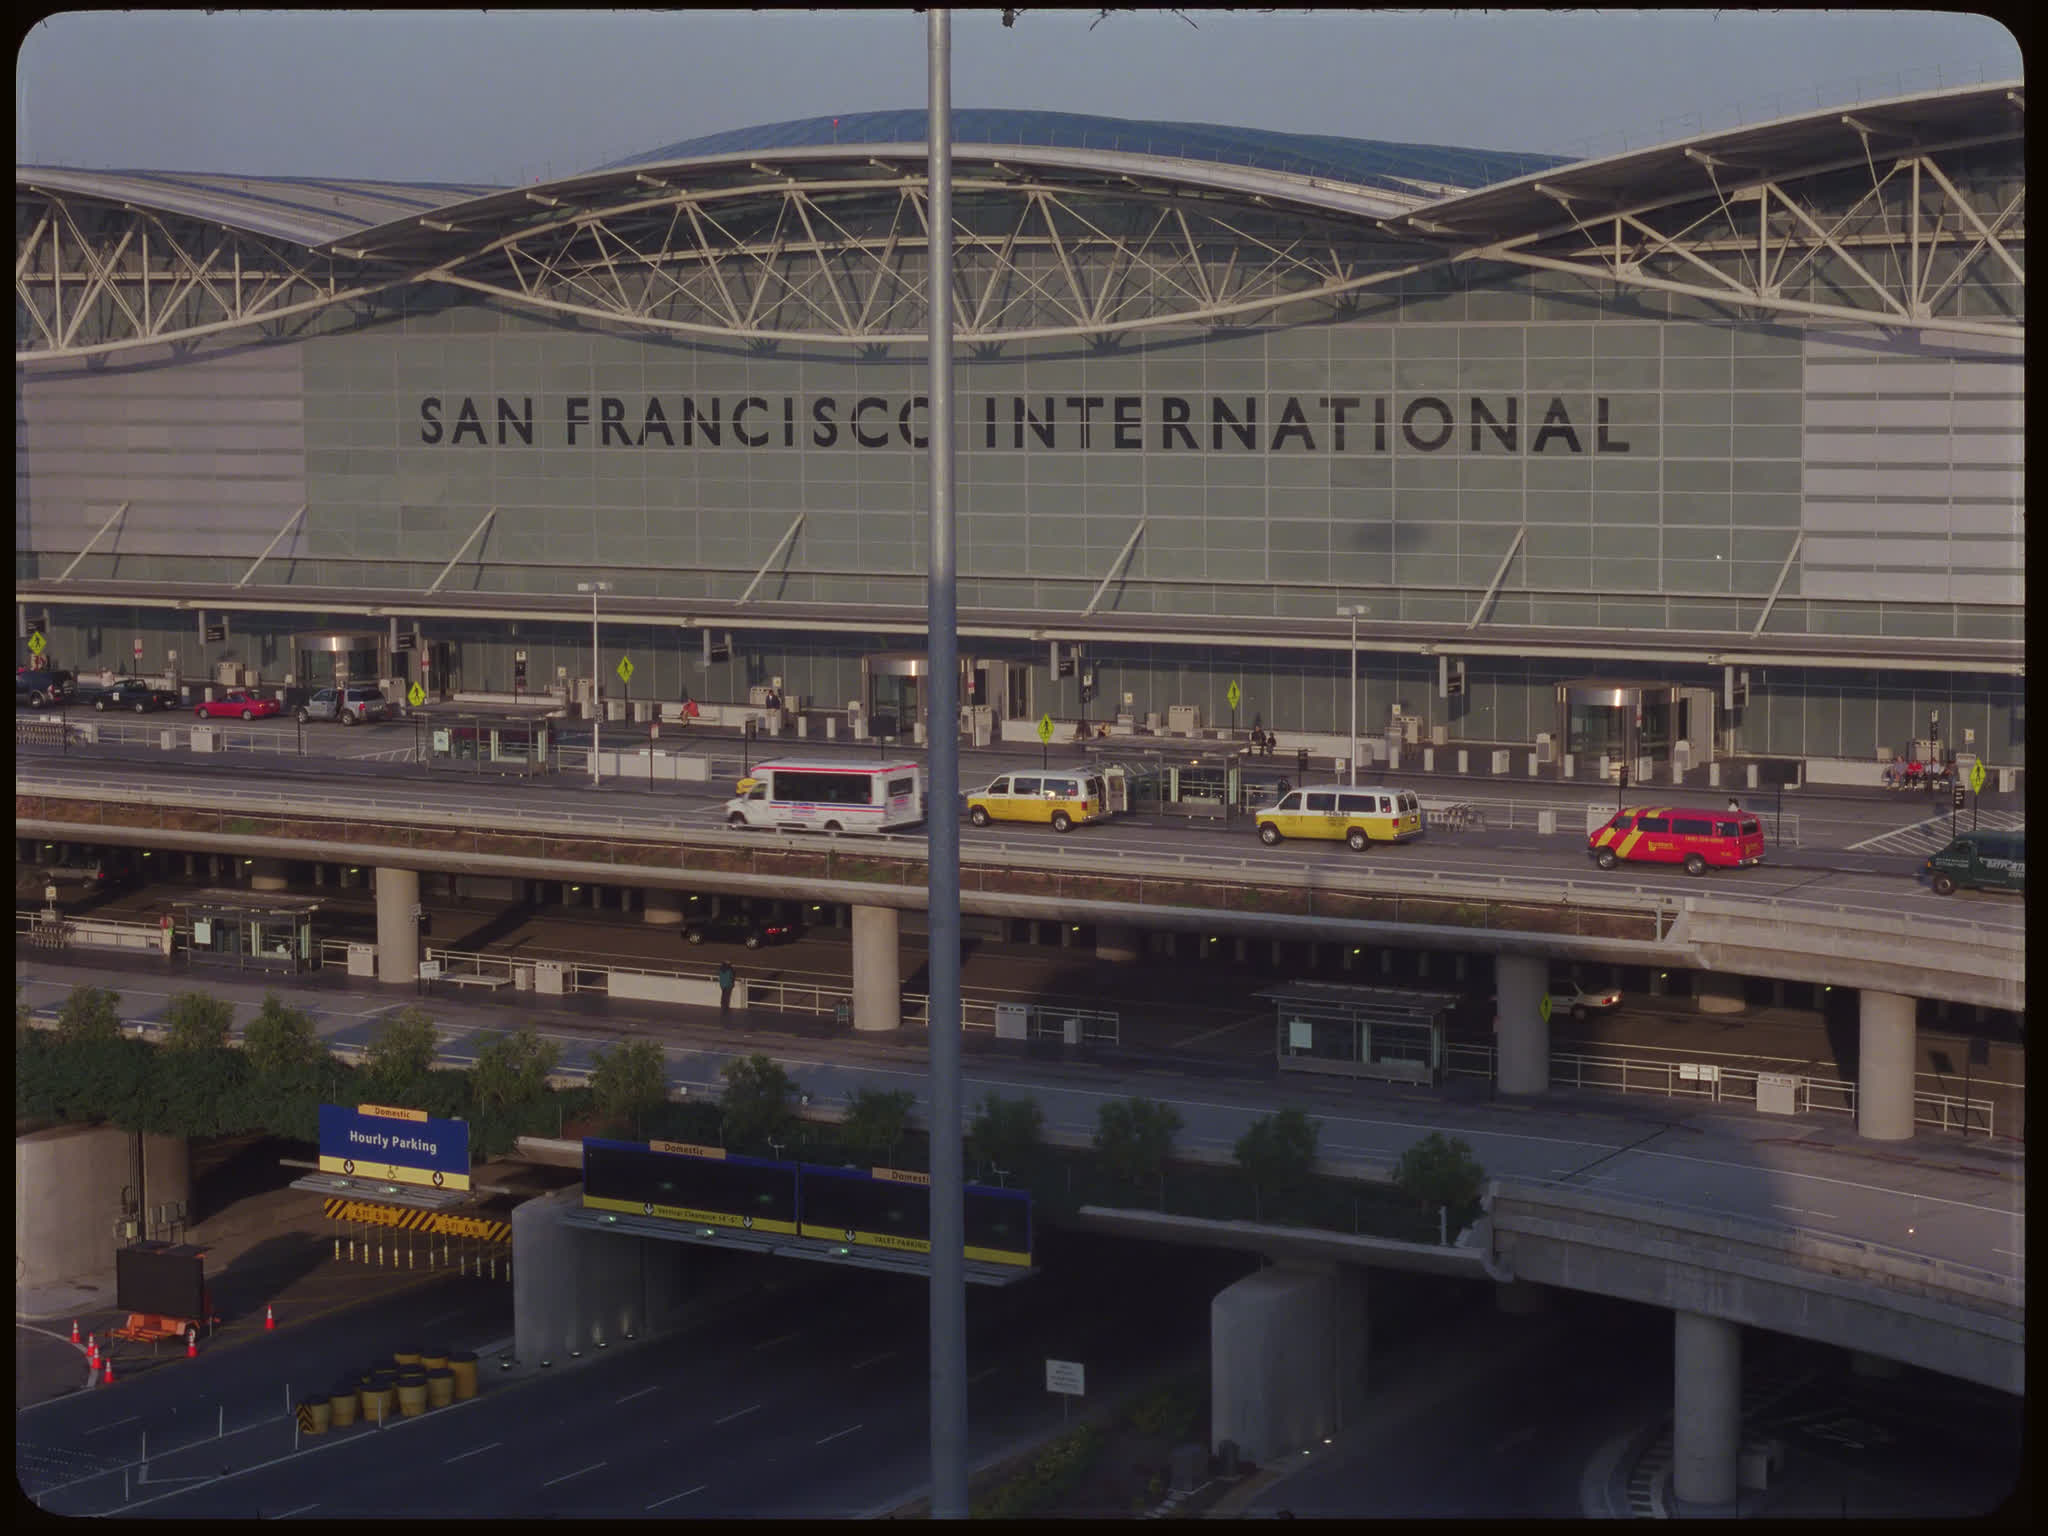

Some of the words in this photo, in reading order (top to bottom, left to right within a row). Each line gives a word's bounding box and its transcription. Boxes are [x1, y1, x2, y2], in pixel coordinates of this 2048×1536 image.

[421, 396, 533, 446] SAN
[986, 395, 1630, 454] INTERNATIONAL
[374, 1107, 411, 1118] Domestic
[350, 1130, 389, 1149] Hourly
[392, 1136, 437, 1155] Parking
[664, 1143, 704, 1156] Domestic
[891, 1171, 929, 1183] Domesti
